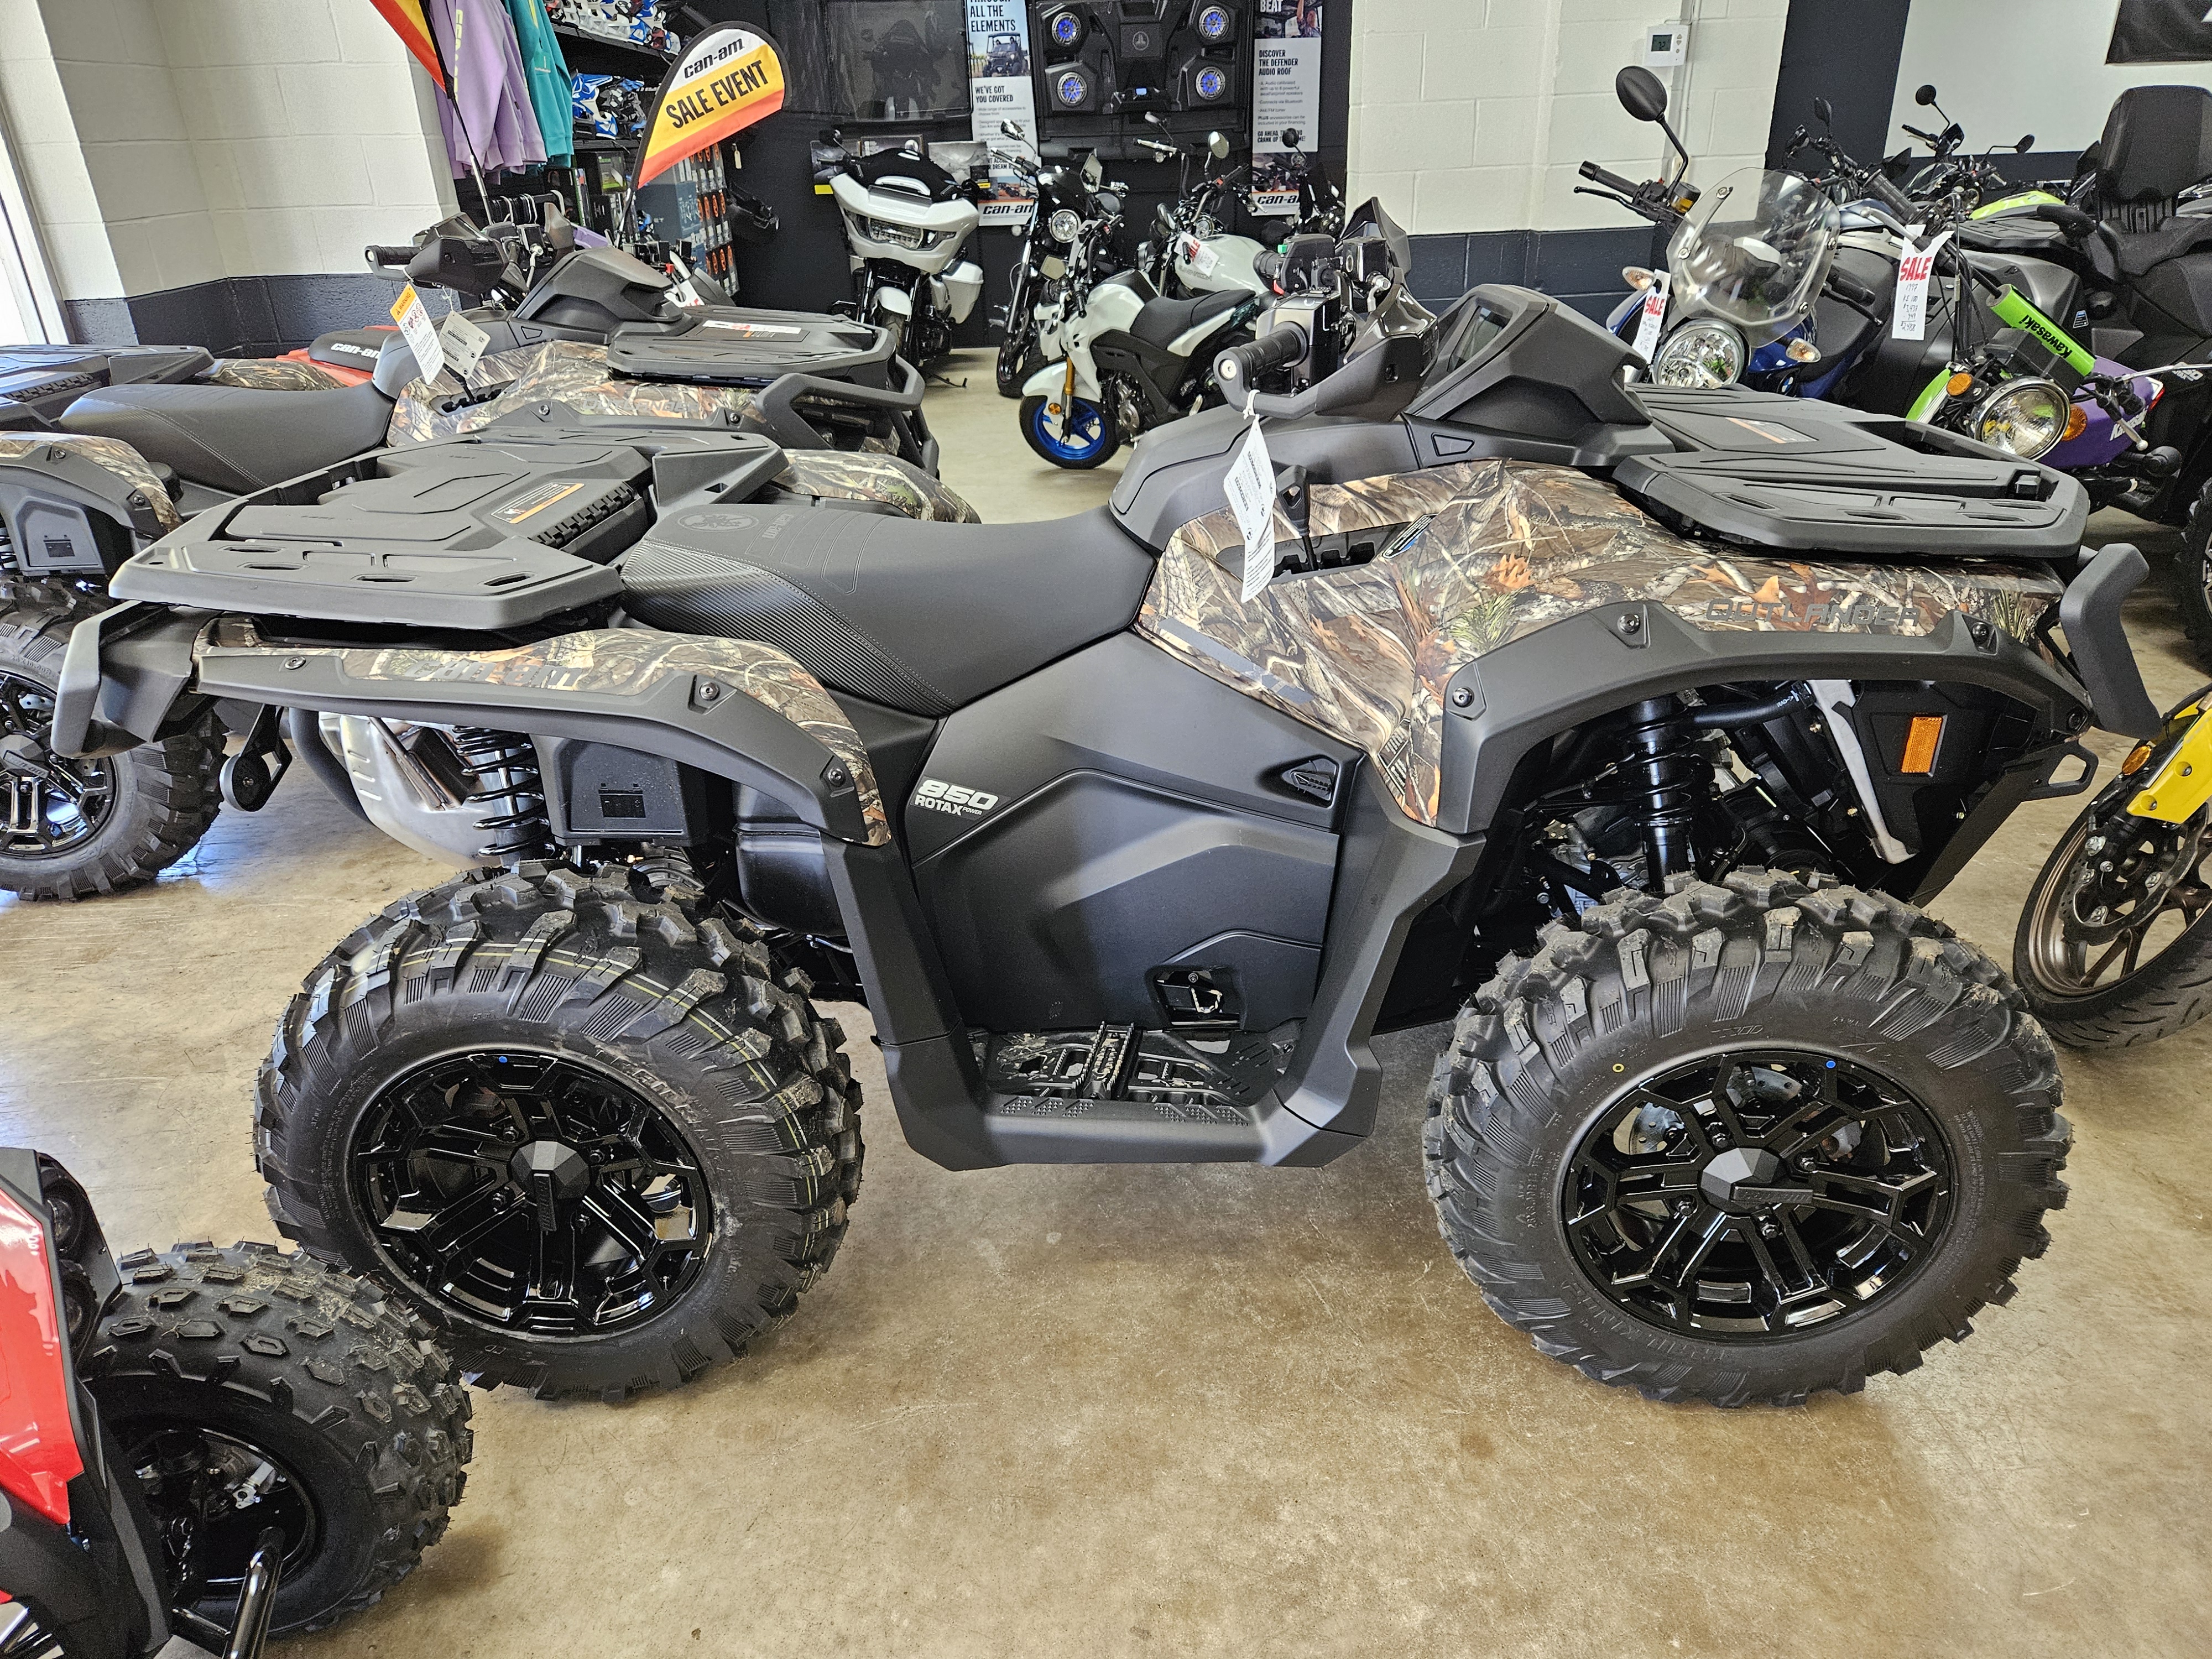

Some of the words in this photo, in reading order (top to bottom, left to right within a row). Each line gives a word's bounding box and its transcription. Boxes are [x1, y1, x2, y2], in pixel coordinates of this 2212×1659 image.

[970, 6, 985, 17] ALL
[987, 5, 1004, 17] THE
[1260, 0, 1283, 12] BEAT
[971, 19, 1016, 32] ELEMENTS
[684, 38, 744, 79] can-am
[666, 88, 714, 129] SALE
[710, 60, 768, 107] EVENT
[975, 86, 992, 95] WE'VE
[989, 95, 1014, 103] COVERED
[1257, 195, 1299, 205] can-a
[1900, 256, 1933, 281] SALE
[398, 291, 412, 311] WARNING
[1645, 295, 1666, 316] SALE
[2018, 314, 2073, 359] Kawasaki
[1705, 598, 1921, 627] OUTLANDER
[404, 660, 584, 687] can-am
[914, 794, 963, 816] ROTAX
[962, 806, 983, 816] POWER
[918, 780, 999, 810] 850
